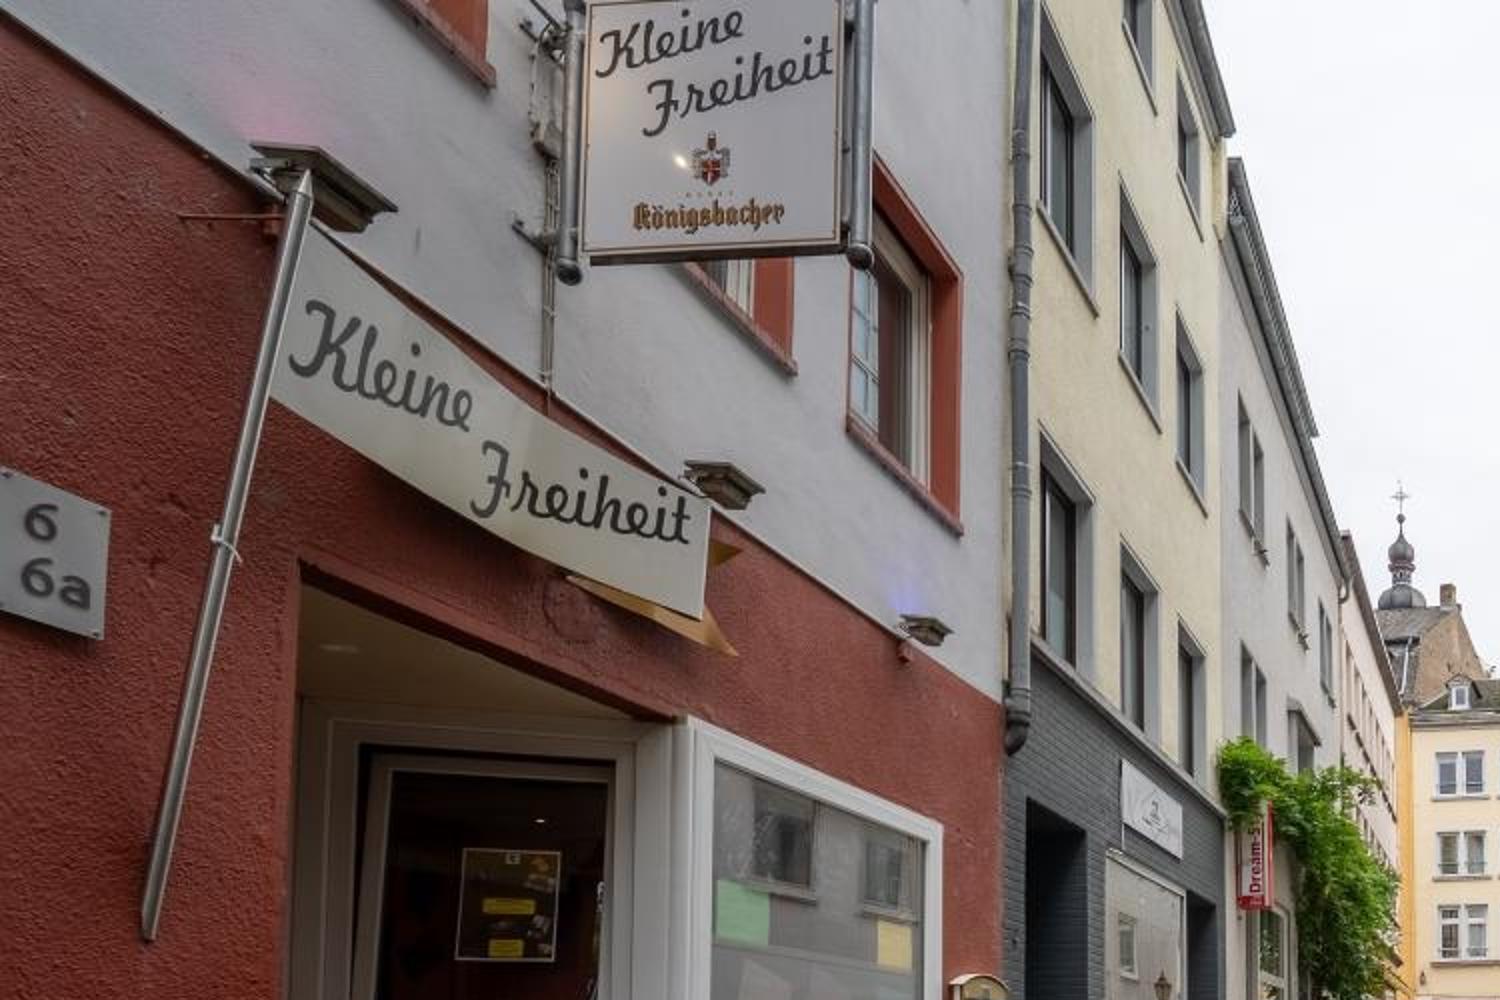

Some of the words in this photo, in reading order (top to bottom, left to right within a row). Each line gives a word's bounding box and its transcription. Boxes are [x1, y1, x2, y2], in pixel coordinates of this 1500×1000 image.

[595, 8, 744, 78] Kleine
[642, 35, 834, 137] Freiheit
[633, 198, 785, 234] Königsbacher
[288, 300, 473, 432] Kleine
[24, 503, 59, 542] 6
[469, 440, 692, 545] Freiheit
[21, 557, 91, 610] 6a
